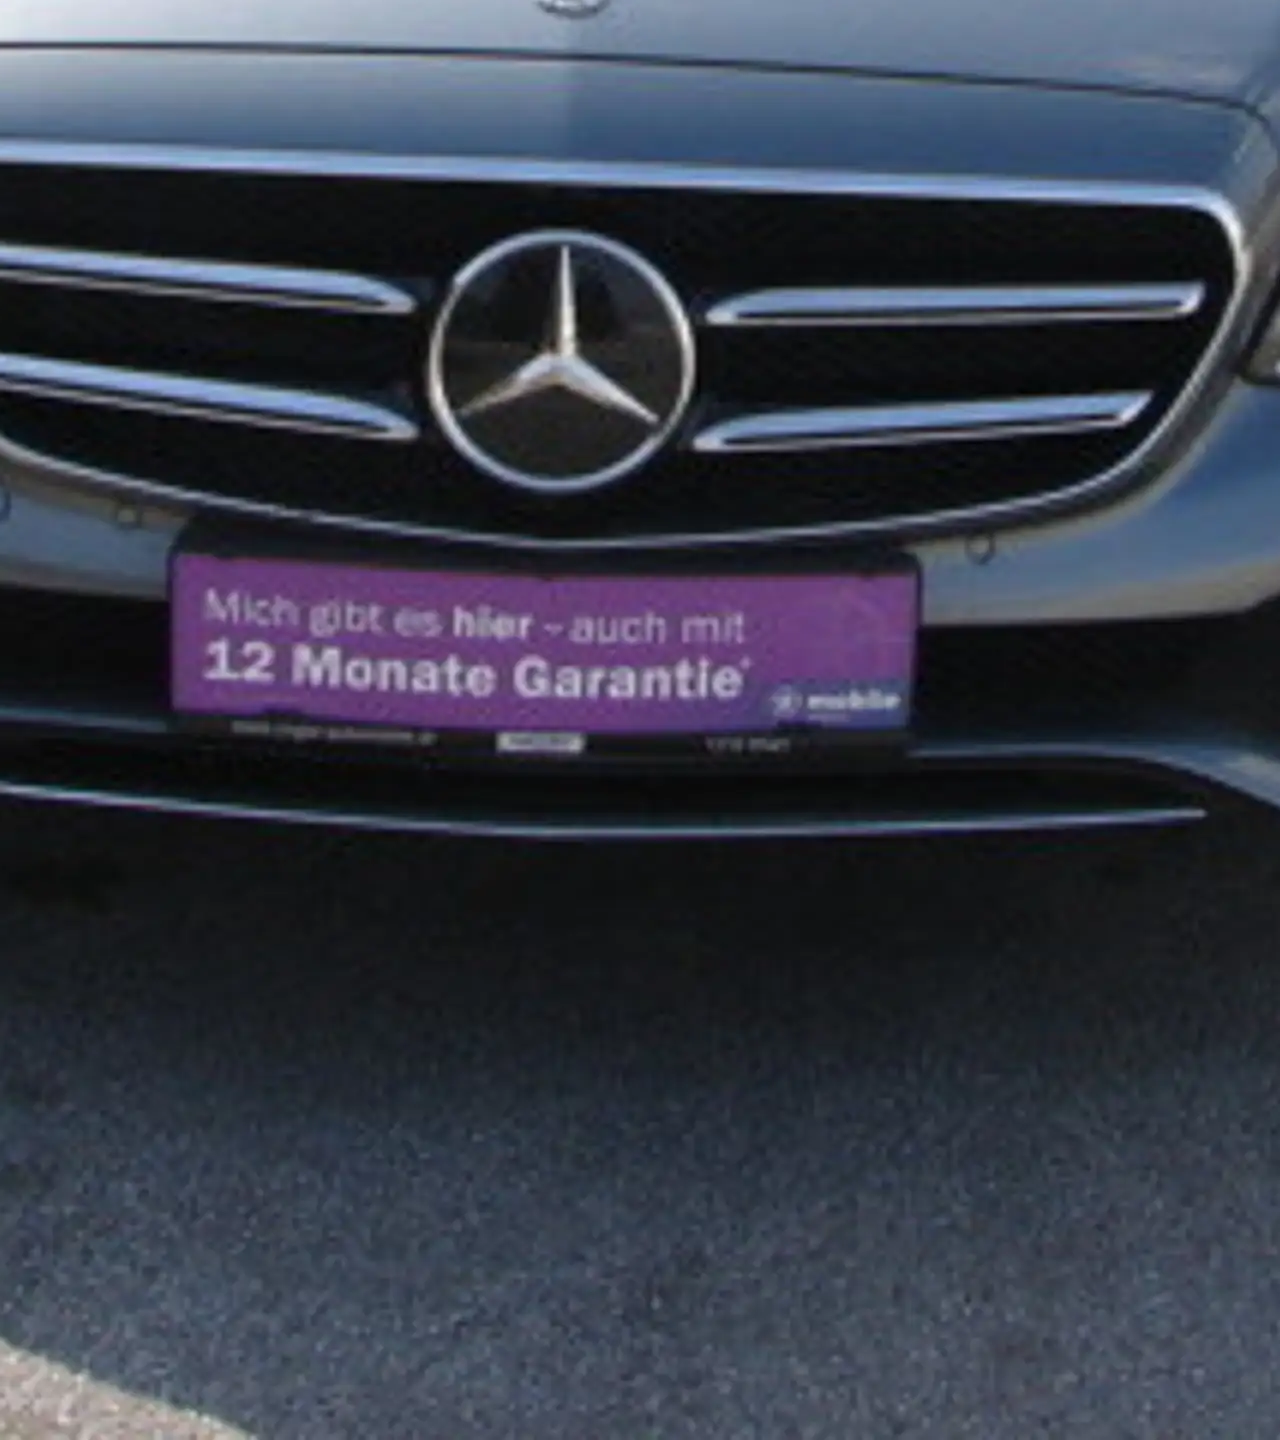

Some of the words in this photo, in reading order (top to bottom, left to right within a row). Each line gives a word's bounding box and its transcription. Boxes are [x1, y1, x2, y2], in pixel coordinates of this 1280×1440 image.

[205, 588, 300, 627] Mich
[309, 600, 386, 639] gibt
[393, 609, 442, 638] es
[453, 605, 534, 640] hier
[569, 611, 666, 644] auch
[681, 611, 746, 645] mit
[204, 636, 276, 684] 12
[291, 642, 497, 698] Monate
